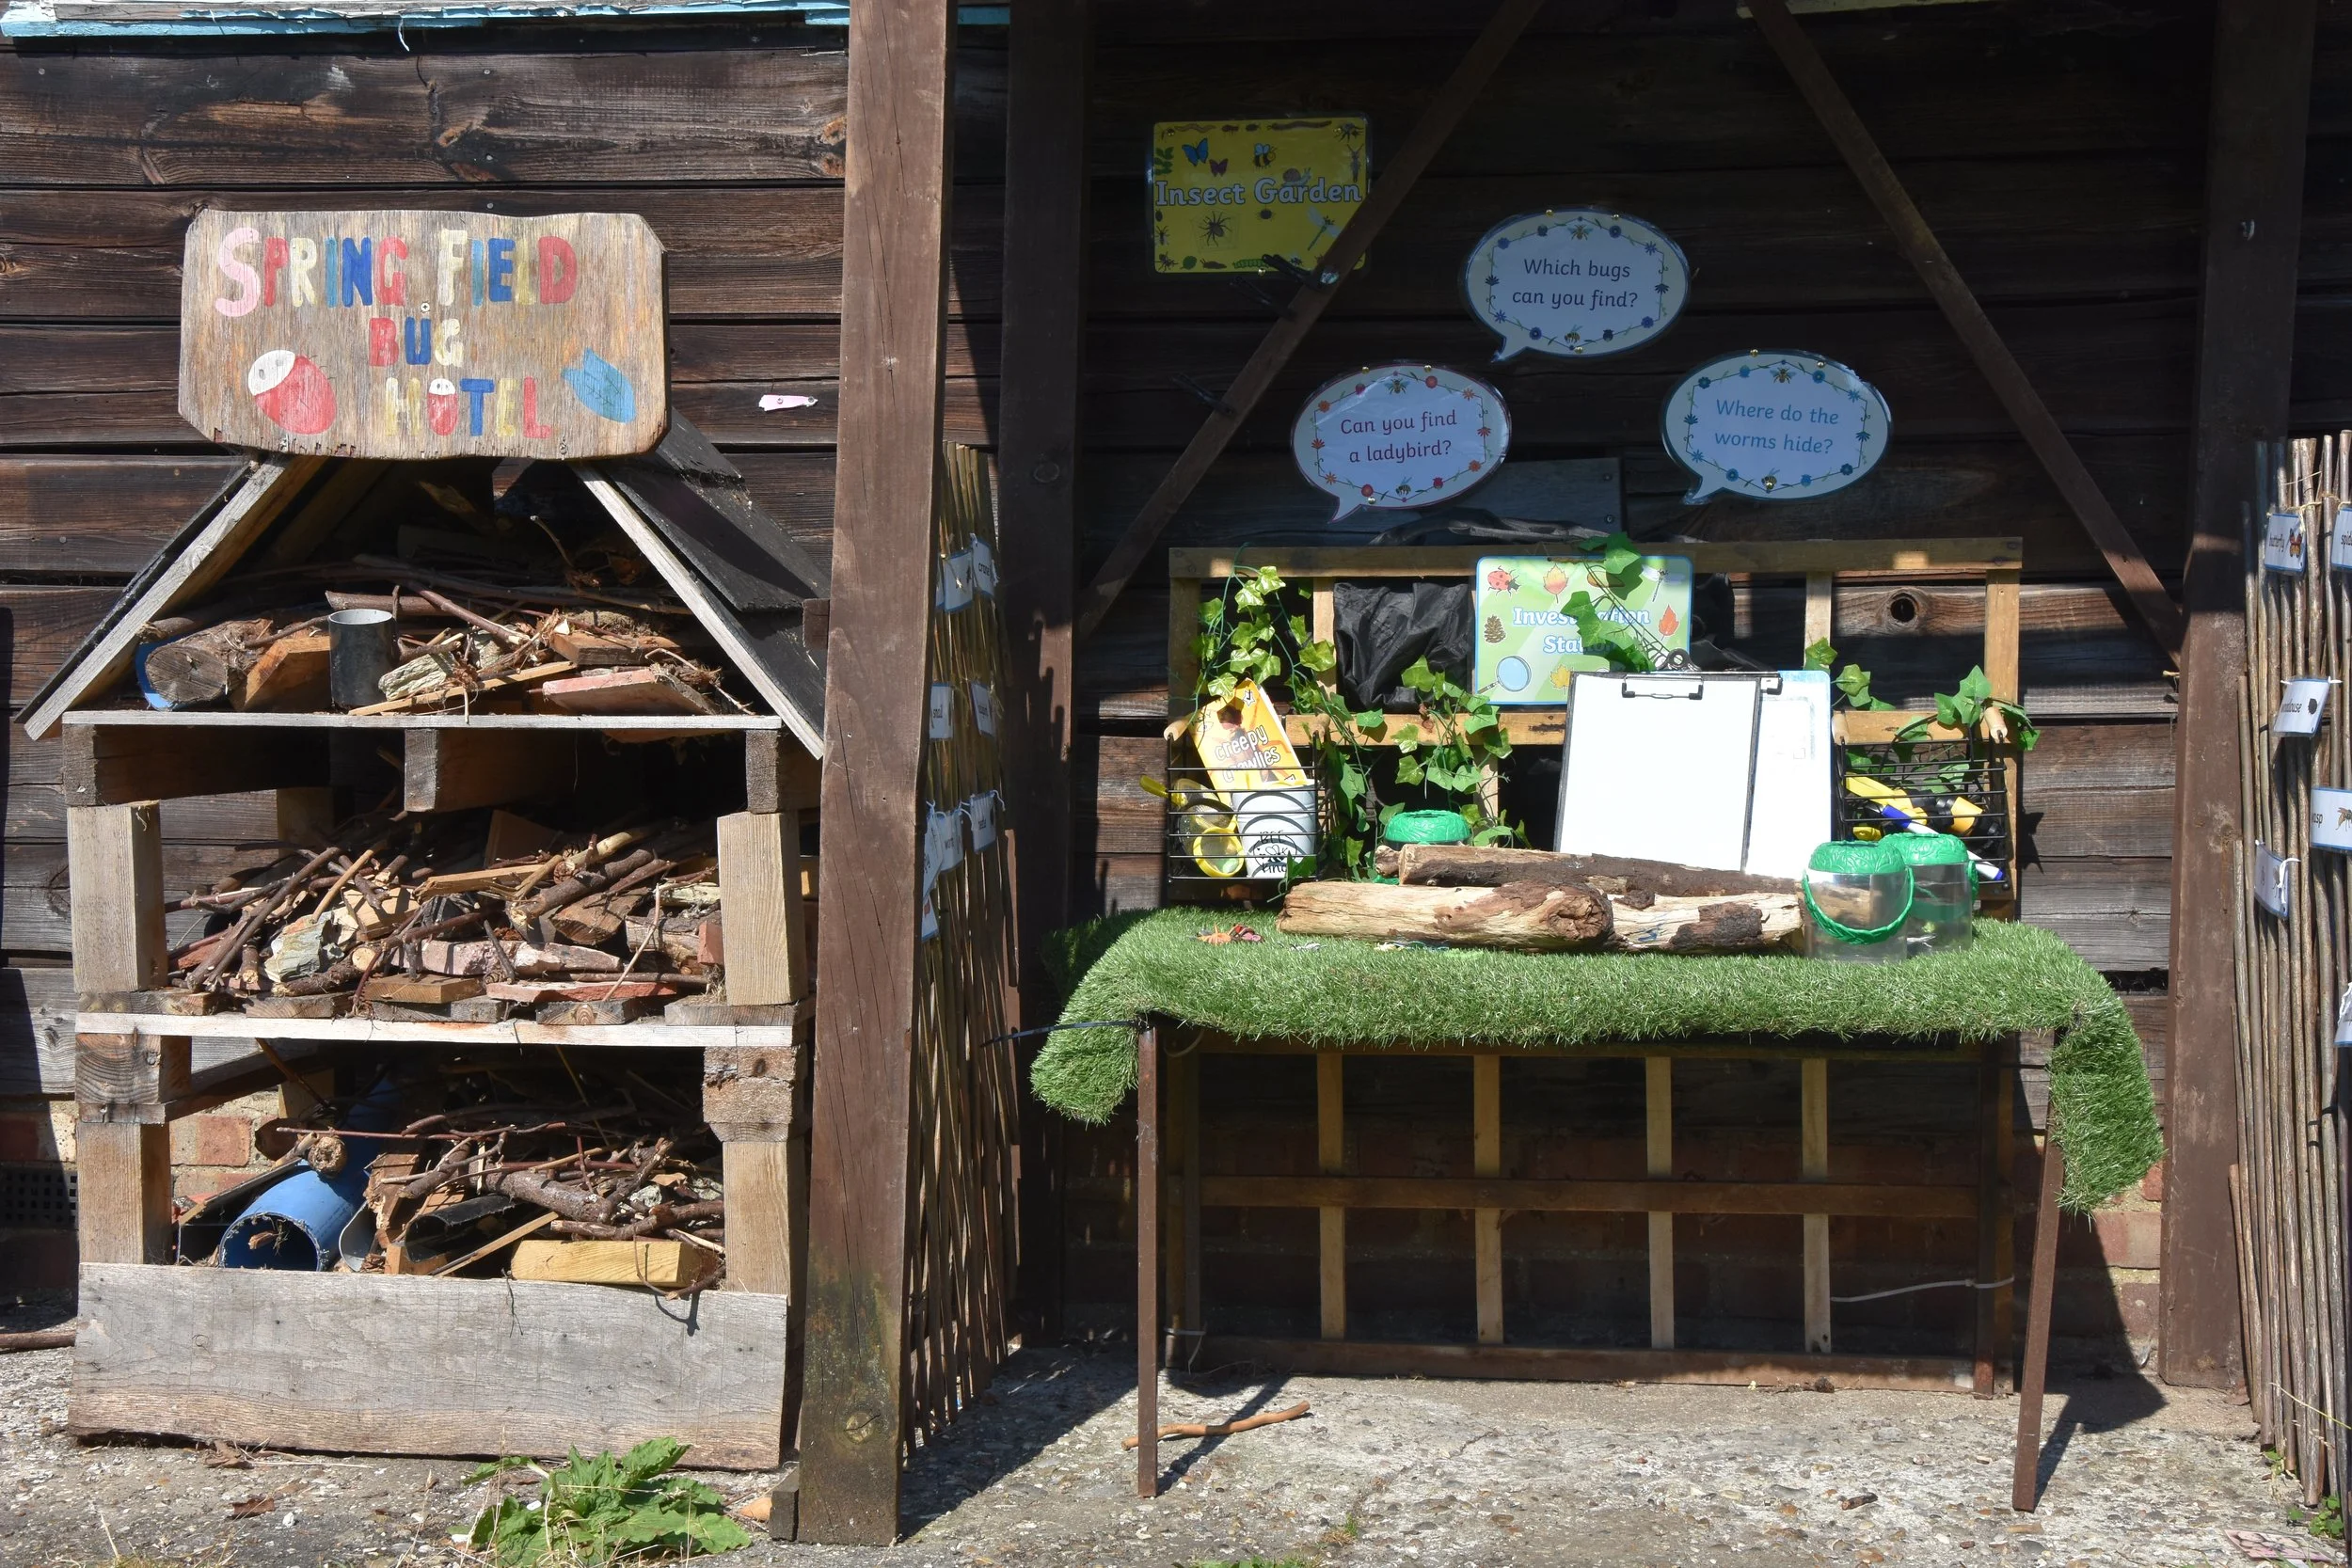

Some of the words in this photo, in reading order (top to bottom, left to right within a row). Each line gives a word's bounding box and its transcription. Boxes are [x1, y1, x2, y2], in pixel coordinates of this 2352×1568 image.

[1155, 181, 1246, 206] Insect
[1253, 177, 1362, 204] Garden
[215, 226, 408, 317] SPRING
[437, 229, 579, 307] FIELD
[1524, 258, 1581, 276] Which
[1588, 260, 1630, 282] bugs
[1512, 292, 1544, 304] can
[1551, 293, 1585, 309] you
[1589, 289, 1638, 311] find?
[368, 316, 465, 368] BUG
[1341, 419, 1375, 434] Can
[1382, 417, 1415, 436] you
[1420, 409, 1457, 433] find
[1716, 399, 1774, 420] Where
[1780, 404, 1803, 421] do
[1809, 406, 1839, 425] the
[1349, 451, 1360, 463] a
[1367, 439, 1452, 464] ladybird?
[1714, 432, 1776, 450] worms
[1783, 434, 1834, 454] hide?
[1513, 606, 1651, 626] Invesation
[1215, 723, 1269, 761] creepy
[1222, 746, 1281, 784] cawlies
